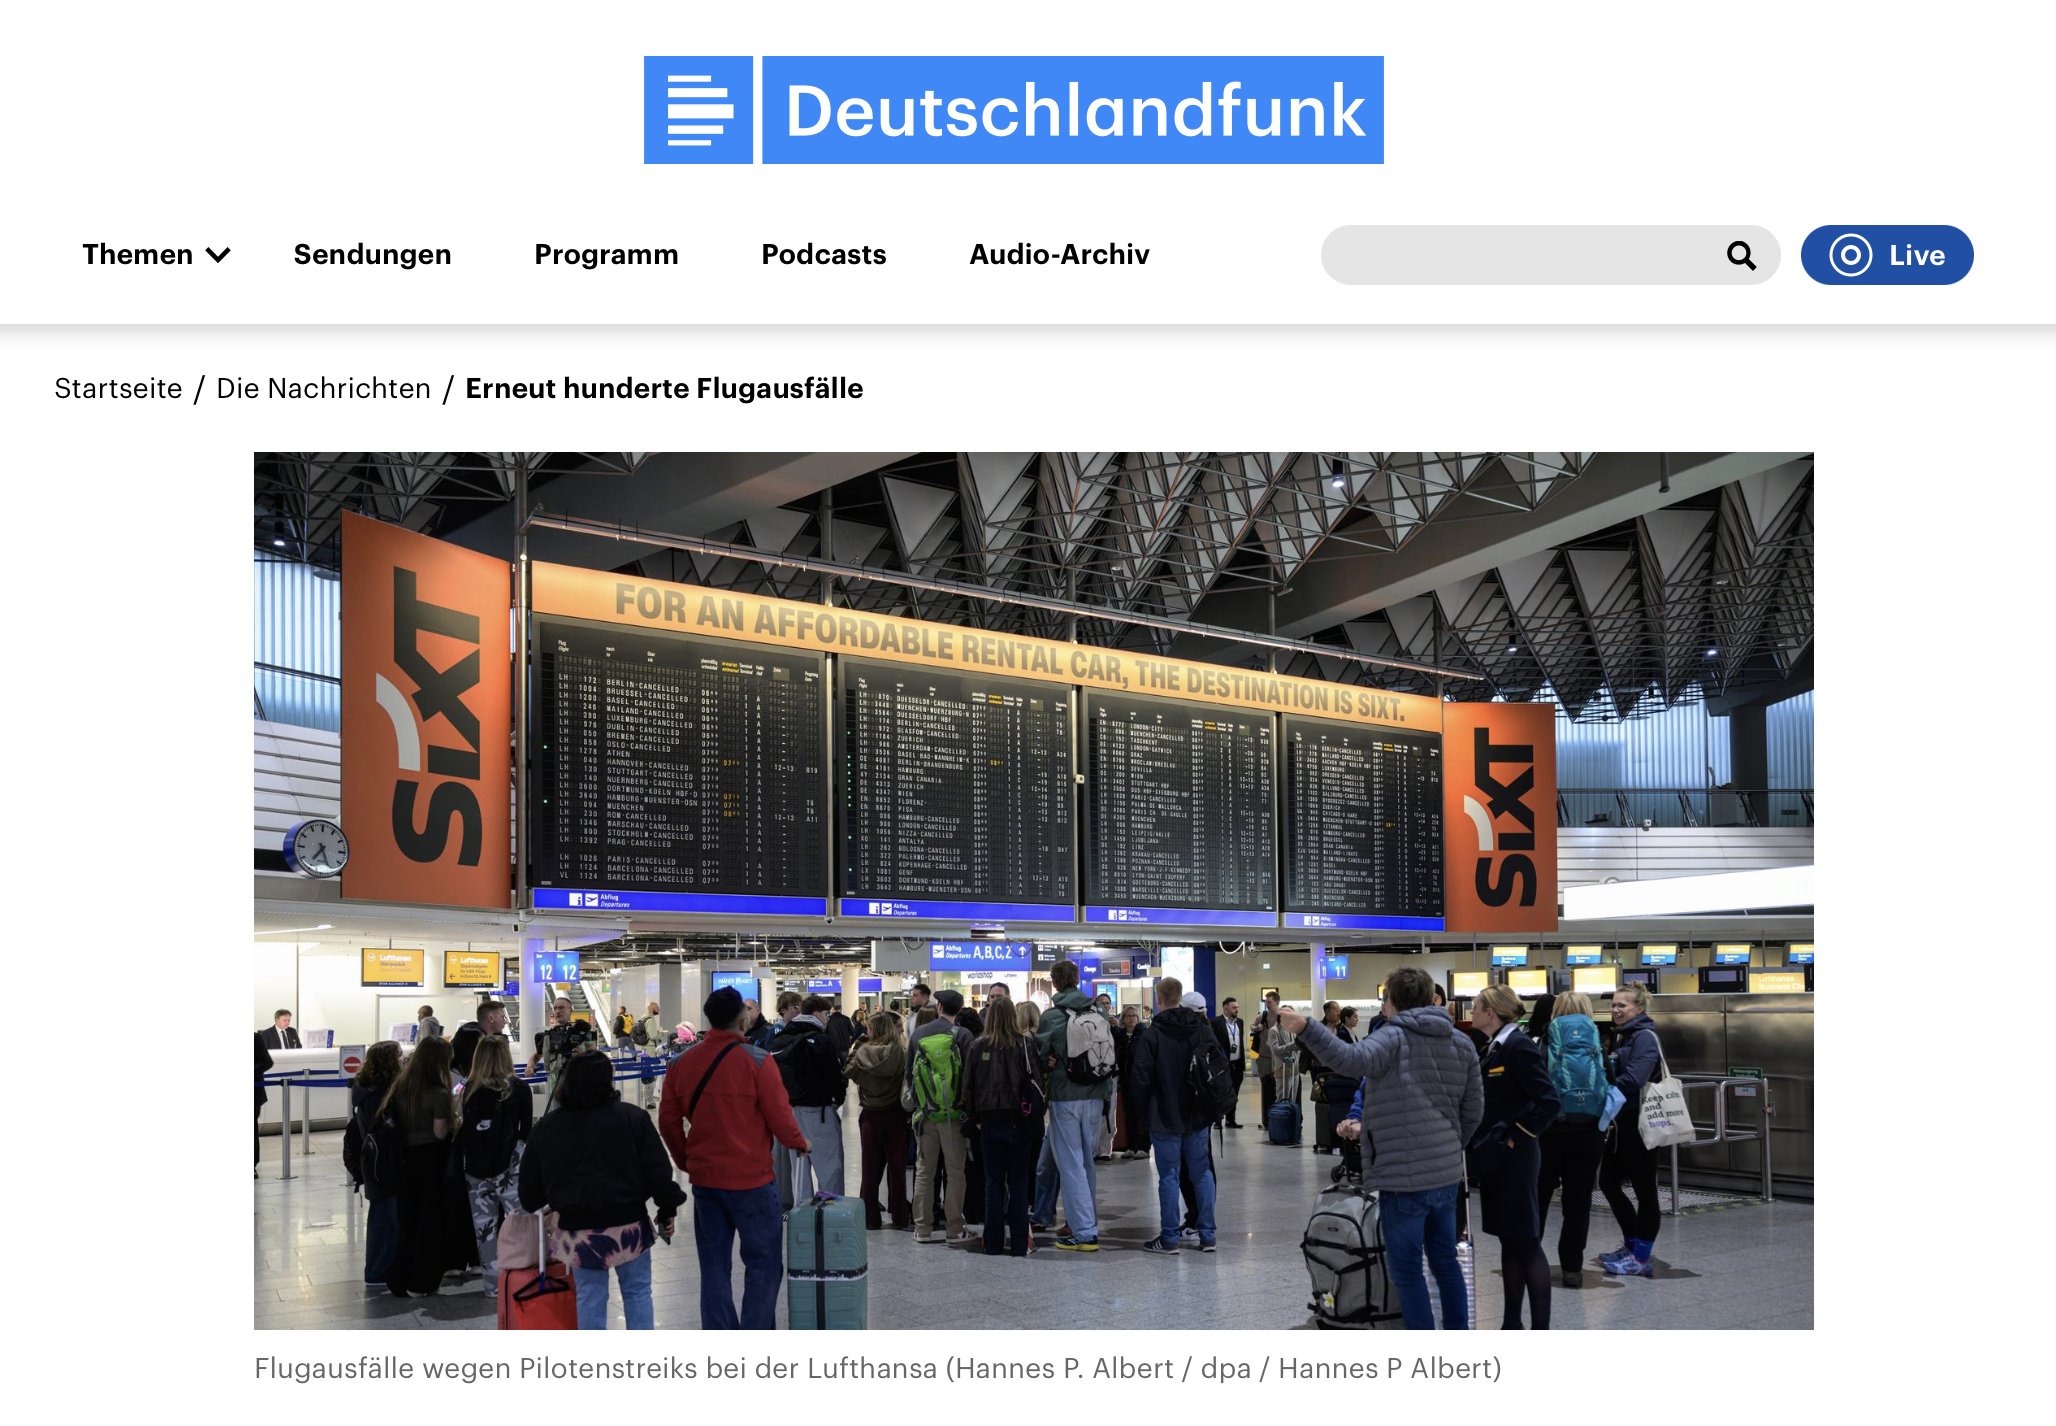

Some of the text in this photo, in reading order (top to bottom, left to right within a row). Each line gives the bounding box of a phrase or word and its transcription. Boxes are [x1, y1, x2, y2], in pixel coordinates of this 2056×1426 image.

[616, 582, 1405, 722] FOR AN AFFORDABLE RENTAL CAR, THE DESTINATION IS SIXT.
[559, 673, 568, 681] LH
[606, 679, 679, 693] BERLIN-CANCELLED
[559, 682, 568, 690] LH
[606, 687, 688, 703] BRUESSEL-CANCELLED
[559, 691, 568, 699] LH
[606, 696, 674, 710] BASEL-CANCELLED
[559, 700, 568, 708] LH
[606, 705, 683, 720] MAILAND-CANCELLED
[606, 714, 693, 729] LUXEMBURG-CANCELLED
[606, 723, 679, 736] DUBLIN-CANCELLED
[606, 732, 679, 745] BREMEN-CANCELLED
[606, 741, 670, 753] OSLO-CANCELLED
[607, 750, 629, 758] ATHEN
[607, 758, 688, 772] HANNOVER-CANCELLED
[607, 767, 693, 781] STUTTGART-CANCELLED
[607, 776, 693, 789] NUERNBERG-CANCELLED
[607, 785, 670, 796] DORTMUND-KOELN
[607, 803, 643, 812] MUENCHEN
[607, 812, 666, 822] ROM-CANCELLED
[607, 821, 689, 832] WARSCHAU-CANCELLED
[607, 830, 693, 841] STOCKHOLM-CANCELLED
[607, 838, 671, 848] PRAG-CANCELLED
[607, 856, 675, 866] PARIS-CANCELLED
[607, 865, 693, 875] BARCELONA-CANCELLED
[607, 874, 693, 884] BARCELONA-CANCELLED
[601, 894, 619, 902] Abflug
[946, 945, 962, 953] Abflug
[380, 954, 412, 962] Lufthansa
[541, 964, 552, 980] 12
[562, 964, 577, 980] 12
[967, 972, 993, 980] worldshop
[1335, 965, 1346, 977] 11
[1642, 1095, 1664, 1105] Keep
[1644, 1102, 1662, 1112] and
[1647, 1109, 1684, 1120] add more
